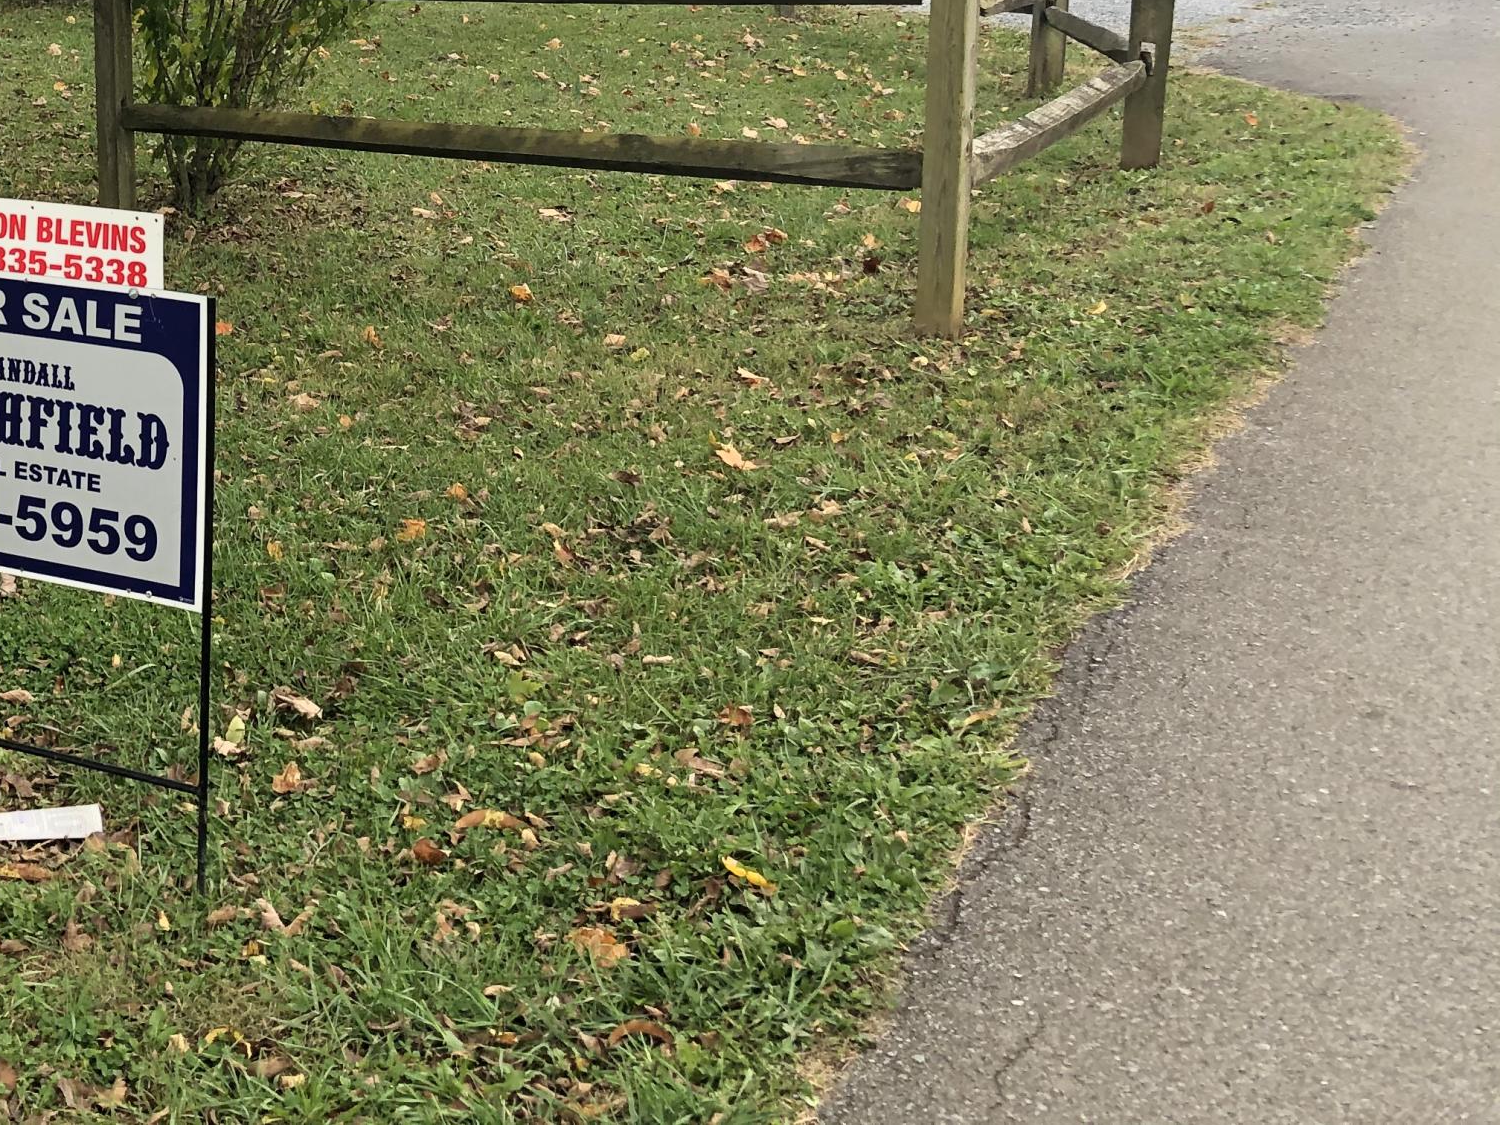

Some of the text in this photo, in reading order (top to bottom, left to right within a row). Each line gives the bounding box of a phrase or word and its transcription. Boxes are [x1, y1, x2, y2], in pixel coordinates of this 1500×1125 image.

[36, 216, 146, 254] BLEVINS
[21, 292, 143, 344] SALE
[14, 461, 102, 493] ESTATE
